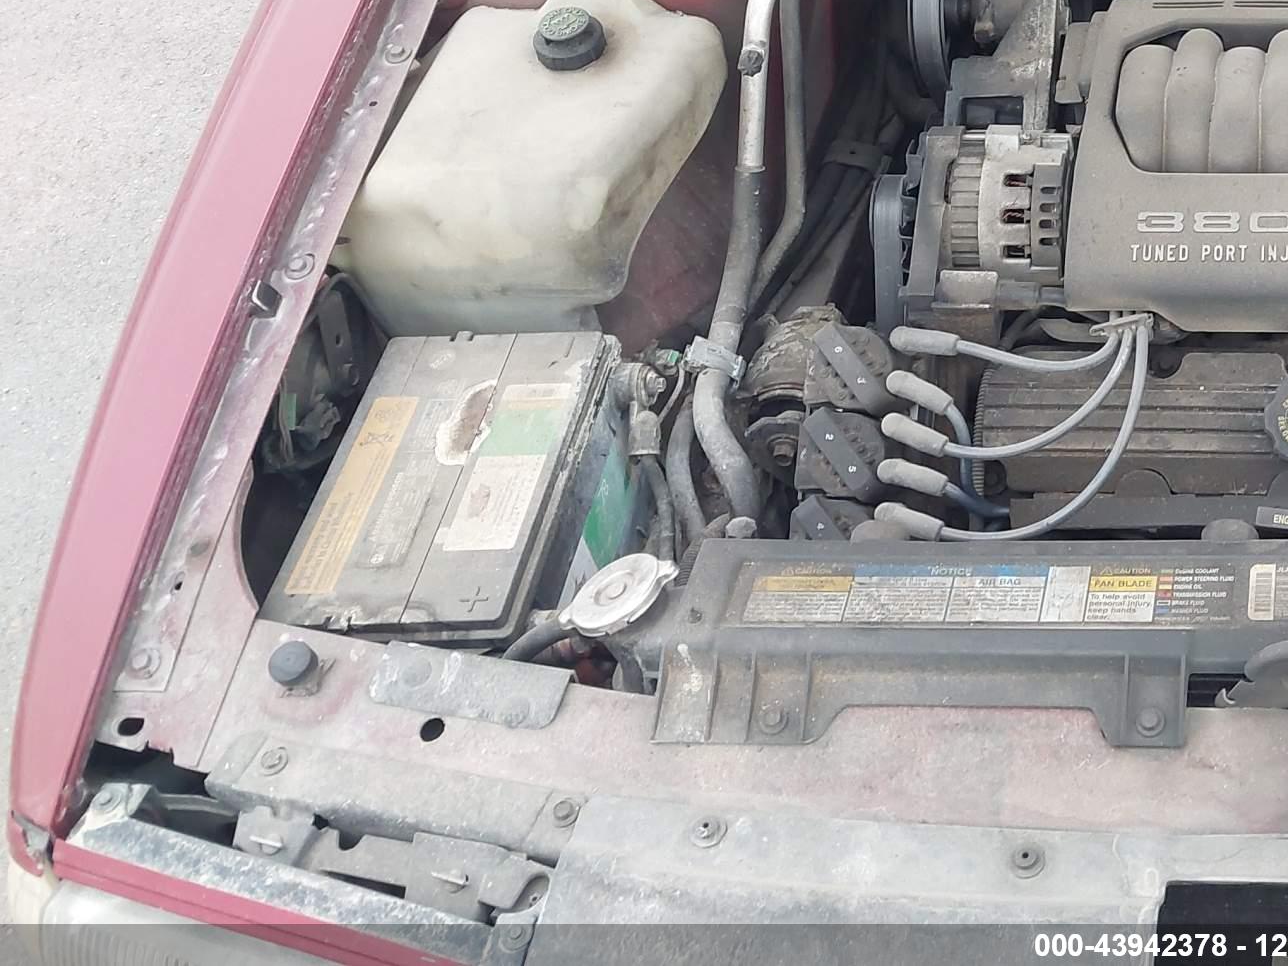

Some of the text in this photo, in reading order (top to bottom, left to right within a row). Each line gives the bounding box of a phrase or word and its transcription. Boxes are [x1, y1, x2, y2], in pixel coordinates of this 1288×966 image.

[1130, 244, 1189, 262] TUNED
[1201, 244, 1249, 262] PORT
[930, 566, 973, 576] NOTICE
[978, 578, 1022, 586] AIR BAG
[1094, 579, 1153, 588] FAN BLADE
[1102, 593, 1121, 602] help
[1122, 593, 1146, 601] avoid
[1089, 601, 1126, 609] personal
[1088, 608, 1109, 616] keep
